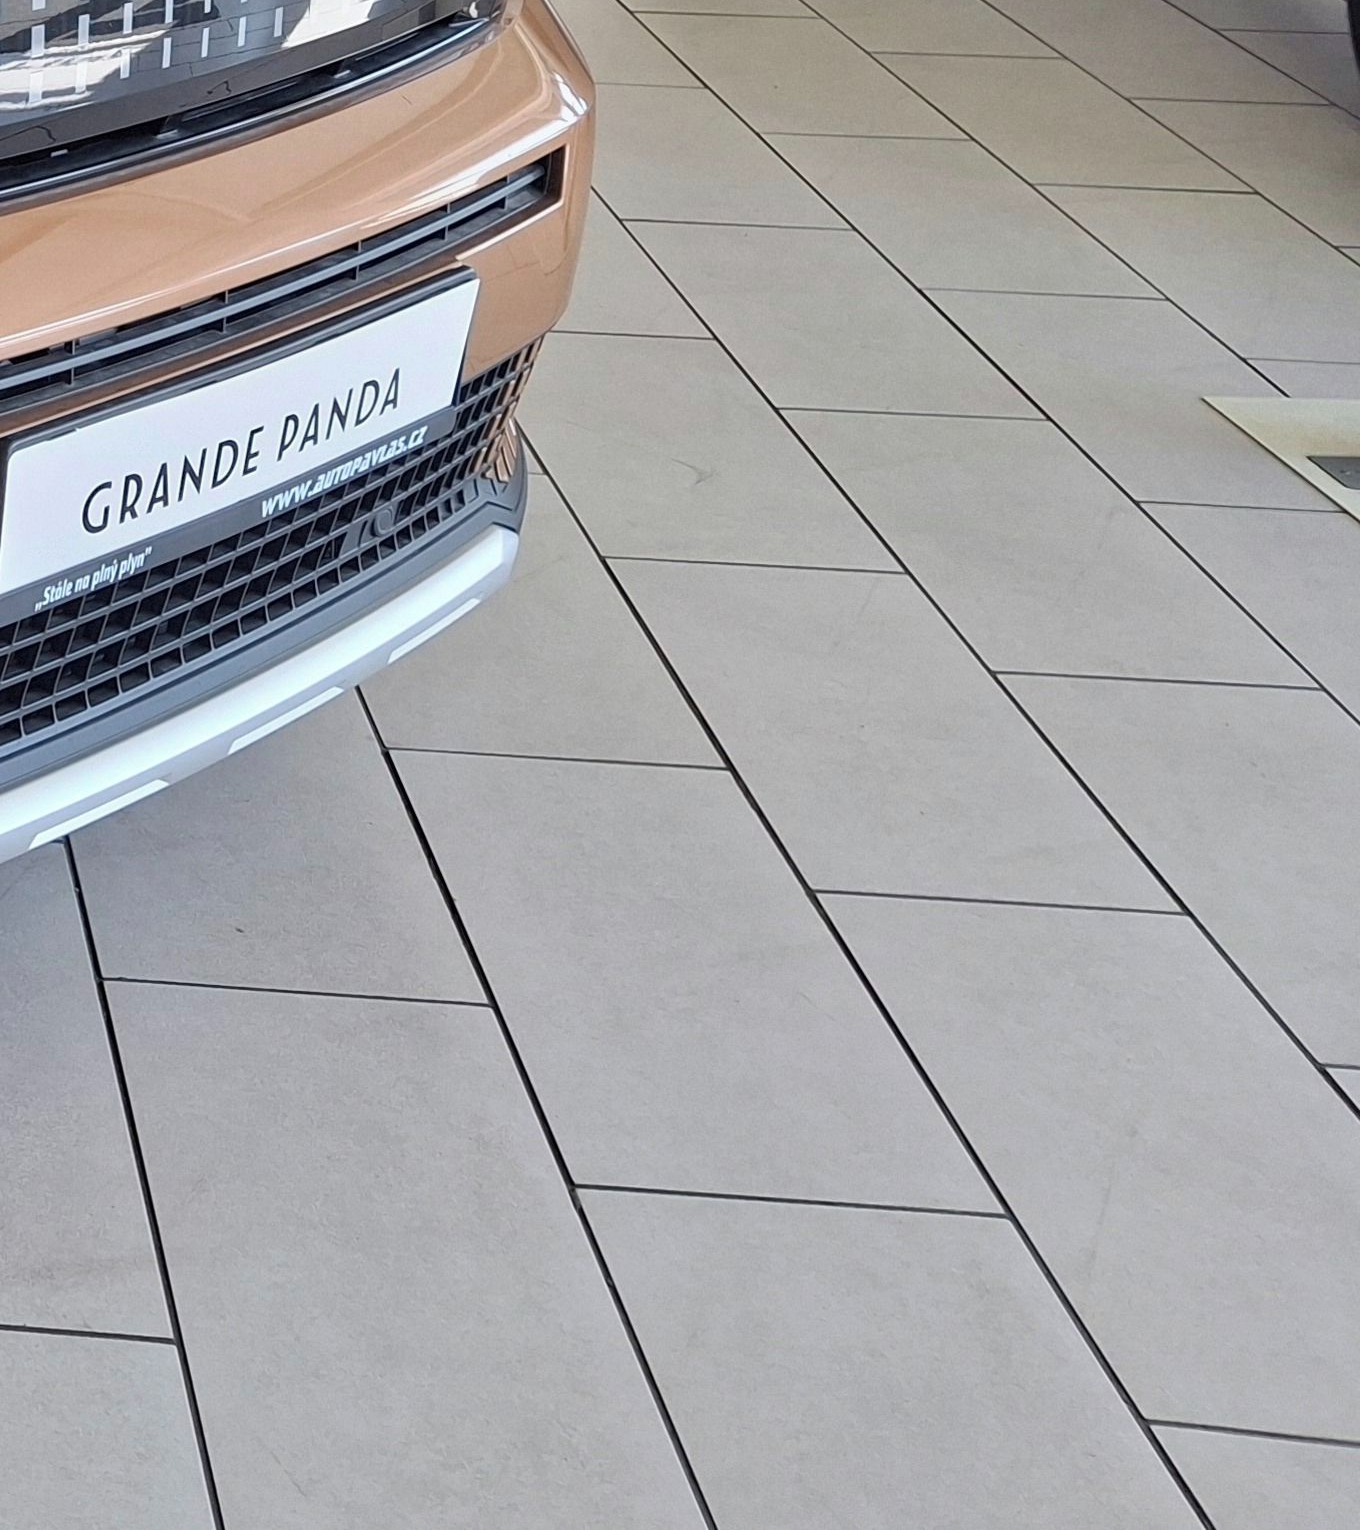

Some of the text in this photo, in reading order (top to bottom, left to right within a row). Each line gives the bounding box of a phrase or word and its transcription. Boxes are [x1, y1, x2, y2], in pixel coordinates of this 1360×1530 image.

[81, 367, 401, 534] GRANDE PANDA
[74, 574, 91, 594] na
[90, 558, 119, 591] plný
